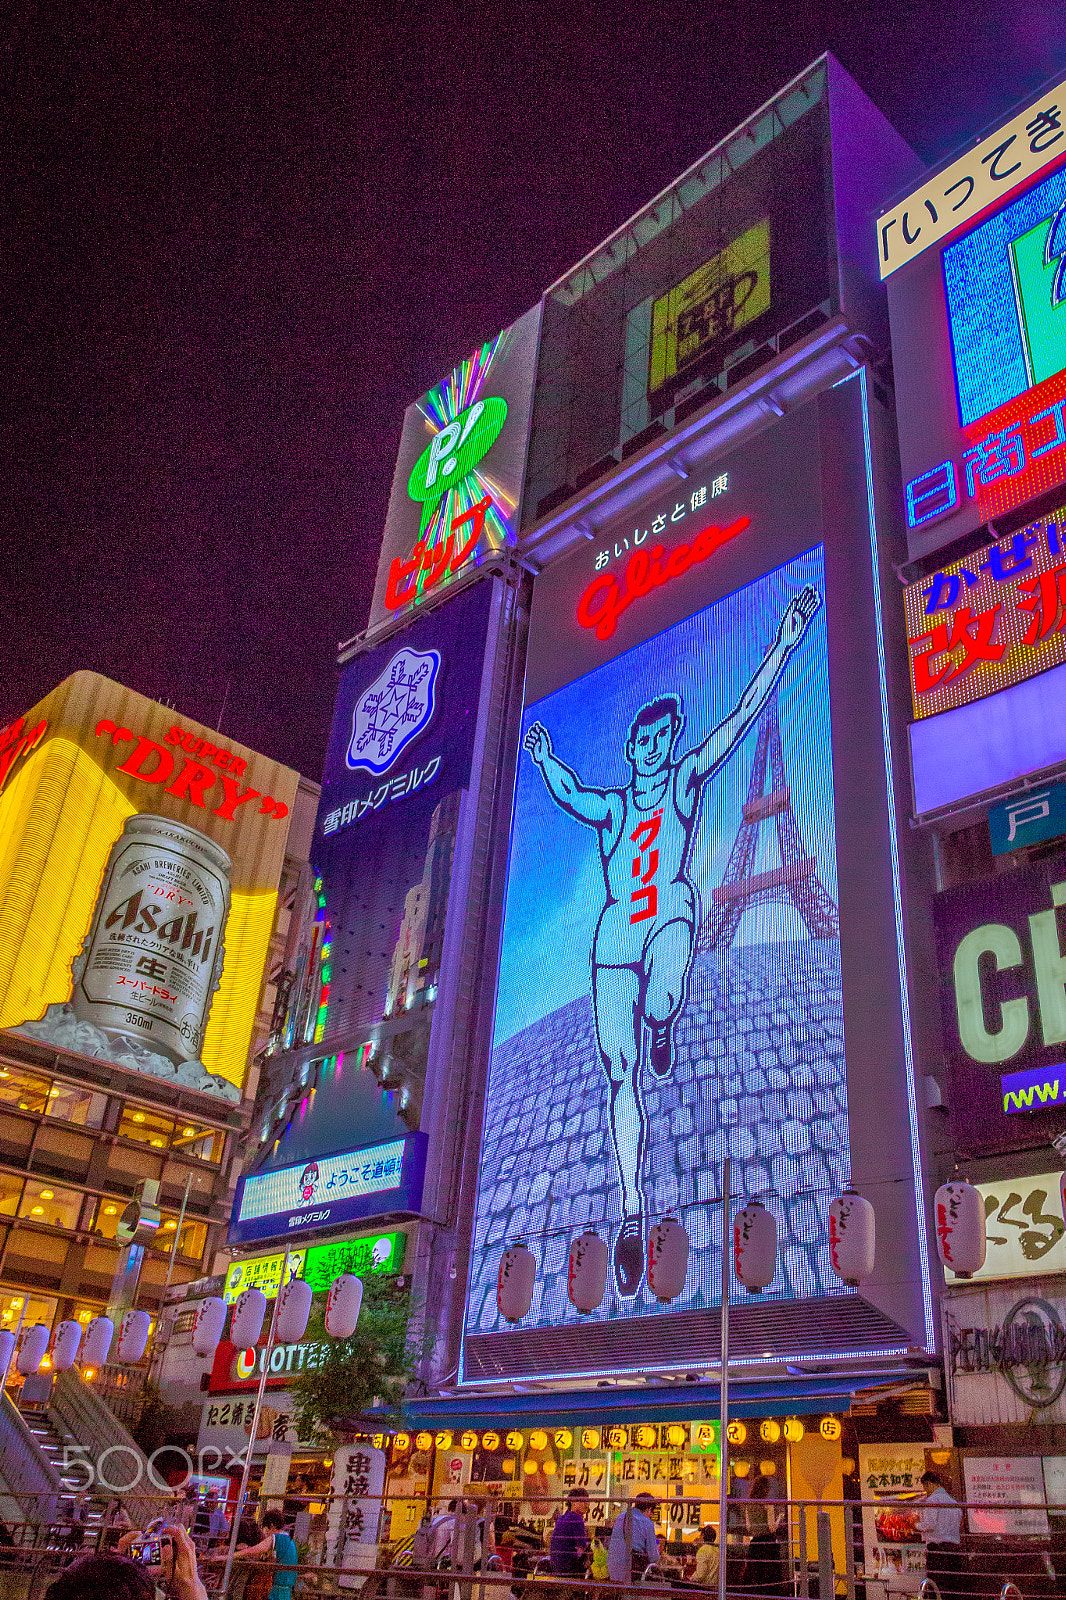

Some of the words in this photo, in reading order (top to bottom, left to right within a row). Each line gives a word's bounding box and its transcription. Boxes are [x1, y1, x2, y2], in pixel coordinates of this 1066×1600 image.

[595, 472, 730, 570] おいしさと健康
[385, 495, 492, 610] ピップ
[576, 515, 751, 640] Glico
[164, 725, 248, 777] SUPER
[324, 755, 441, 836] 雪印メグミルク
[132, 861, 151, 877] ASAHI
[154, 860, 192, 880] BREWERIES
[191, 878, 211, 905] LIMITED
[630, 808, 664, 925] グリコ
[105, 889, 214, 963] Asahi
[116, 976, 178, 1004] スーパードライ
[136, 956, 167, 983] 生
[125, 1012, 154, 1031] 350ml
[130, 991, 158, 1007] 生ビール
[259, 1342, 354, 1374] LOTTE
